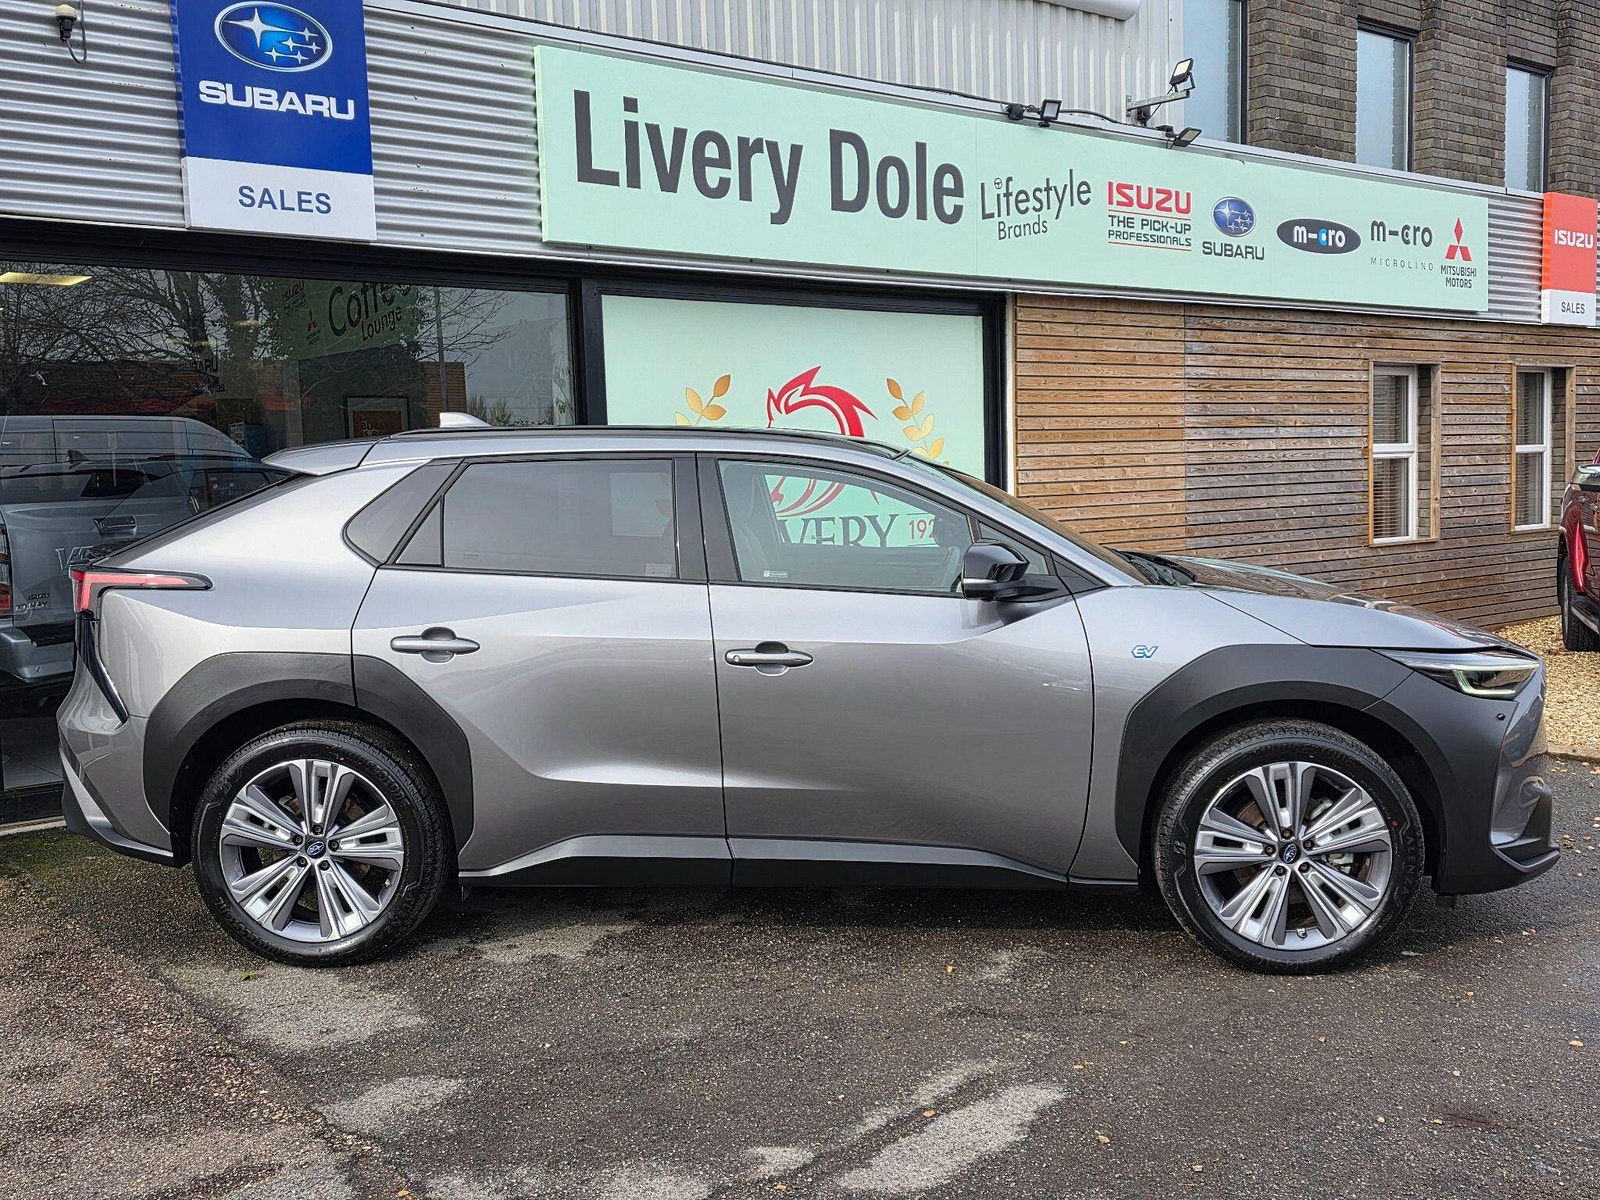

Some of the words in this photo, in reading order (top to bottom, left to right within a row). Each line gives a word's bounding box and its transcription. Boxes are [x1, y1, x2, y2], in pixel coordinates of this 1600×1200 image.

[198, 80, 355, 120] SUBARU
[574, 89, 804, 225] Livery
[829, 128, 965, 225] Dole
[238, 185, 332, 215] SALES
[980, 168, 1092, 220] Lifestyle
[1107, 181, 1192, 214] ISUZU
[998, 214, 1048, 241] Brands
[1108, 214, 1135, 229] THE
[1141, 218, 1192, 235] PICK-UP
[1108, 230, 1192, 247] PROFESSIONALS
[1554, 229, 1593, 249] ISUZU
[1202, 240, 1266, 261] SUBARU
[1370, 257, 1434, 272] MICROLINO
[1440, 265, 1477, 278] MITSUBISHI
[1445, 278, 1472, 289] MOTORS
[1561, 302, 1586, 315] SALES
[361, 305, 402, 342] Lounge
[1131, 644, 1159, 659] EV
